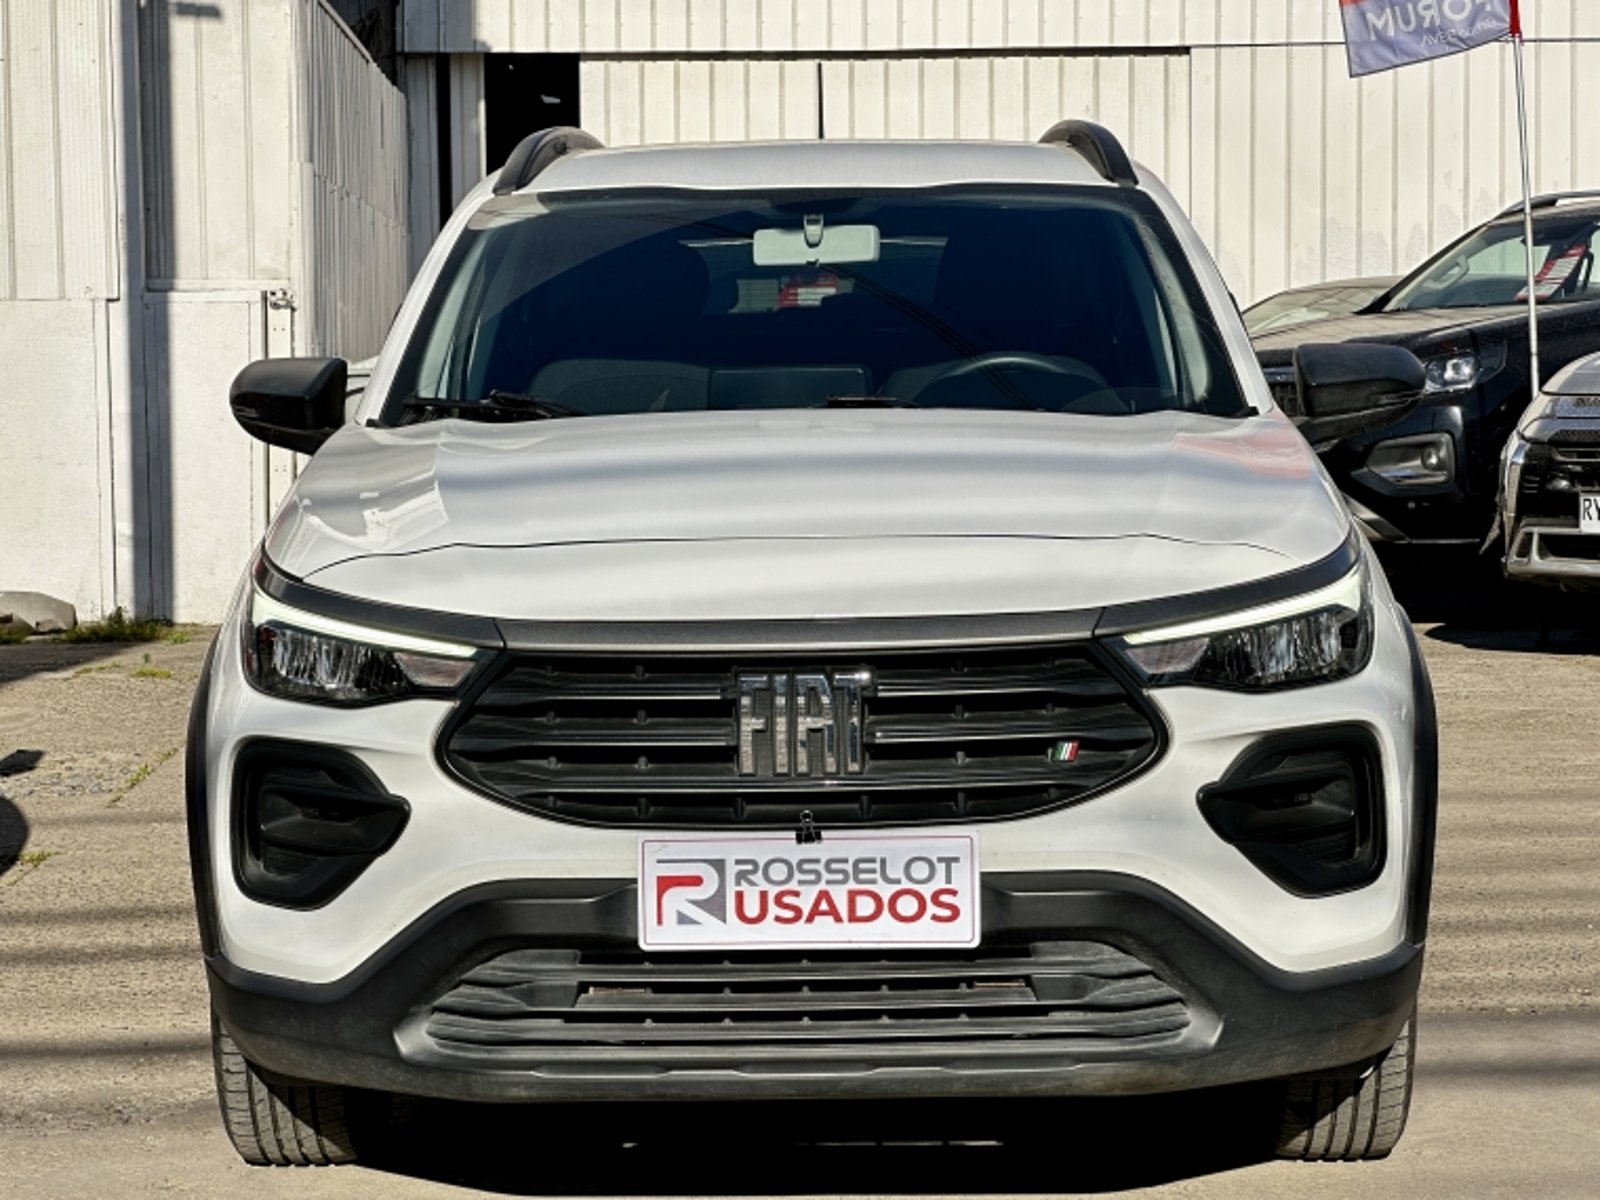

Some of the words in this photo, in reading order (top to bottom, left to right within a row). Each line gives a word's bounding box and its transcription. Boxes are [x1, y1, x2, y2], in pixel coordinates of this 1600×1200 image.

[739, 673, 872, 774] FIAT
[734, 856, 961, 888] ROSSELOT
[734, 888, 961, 926] USADOS
